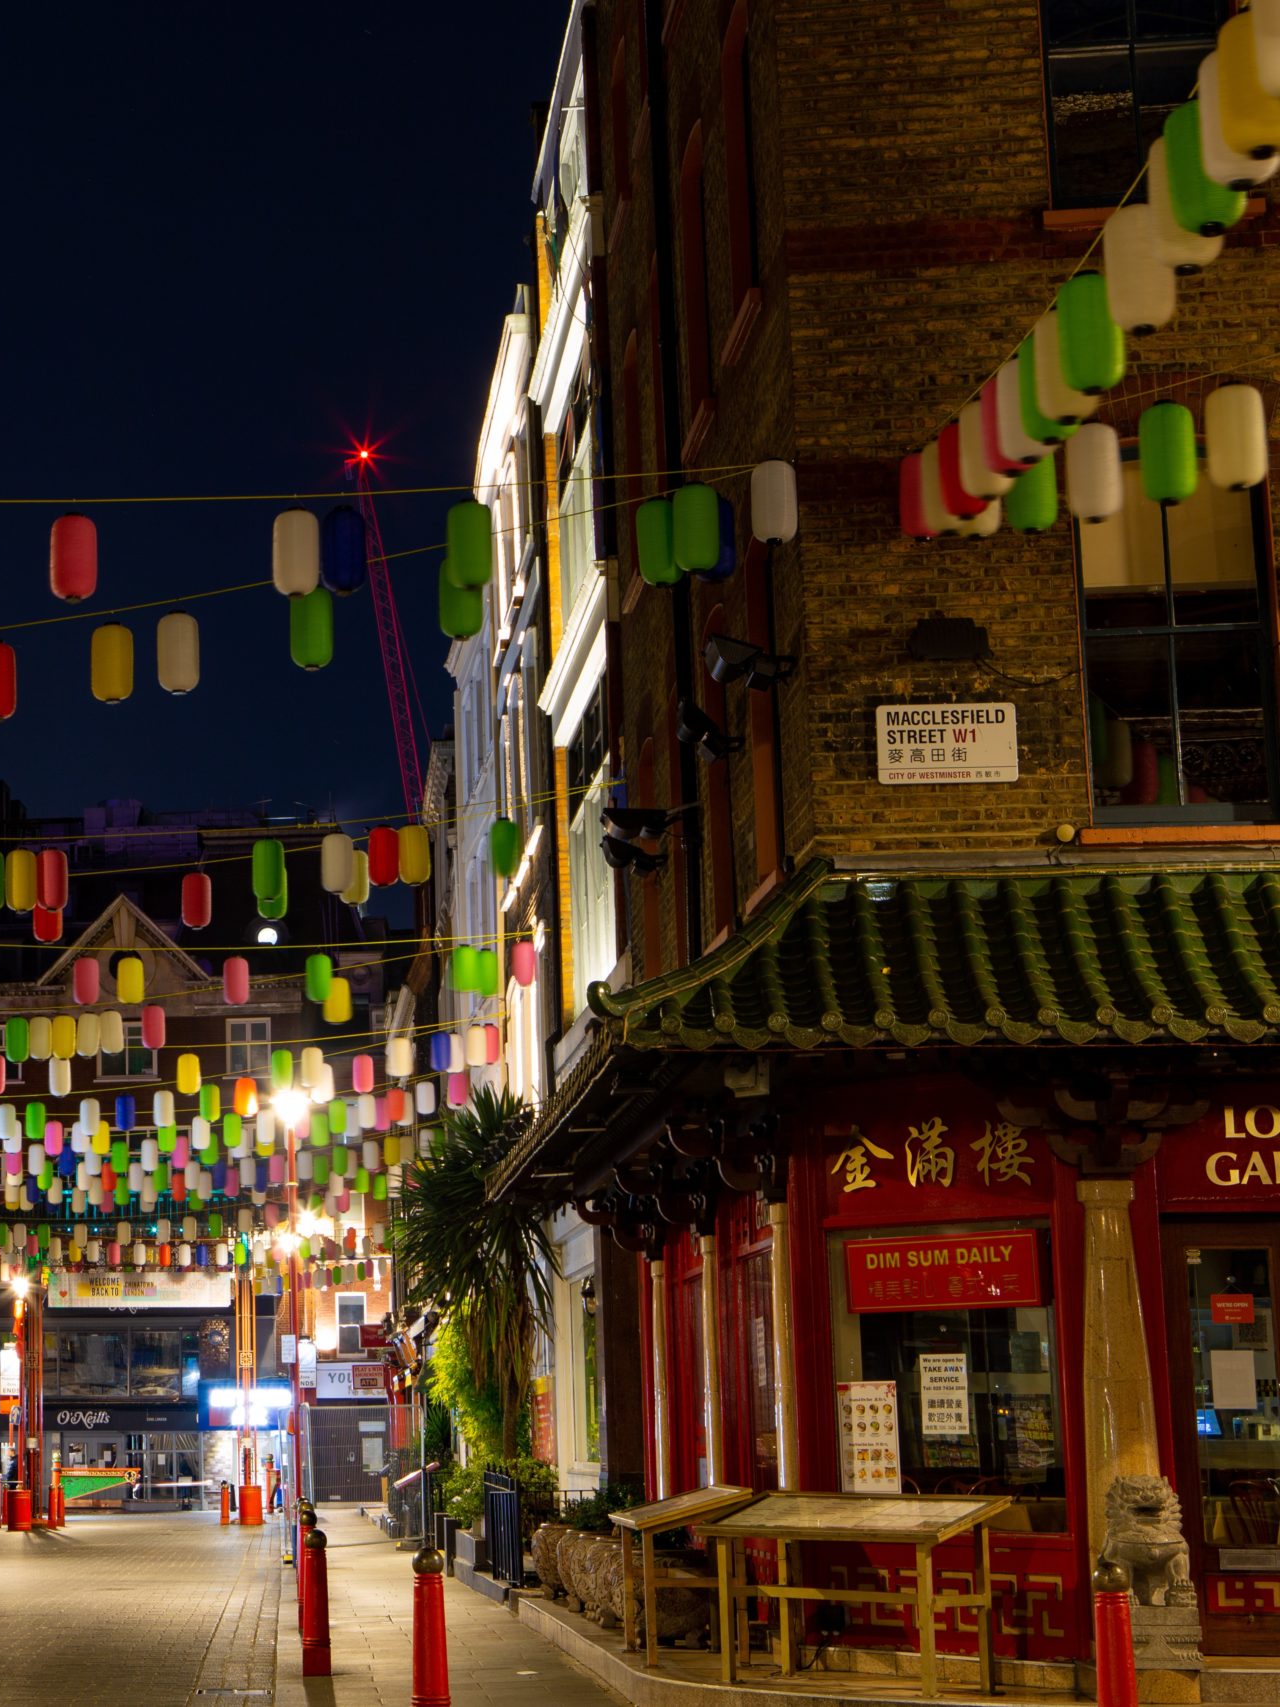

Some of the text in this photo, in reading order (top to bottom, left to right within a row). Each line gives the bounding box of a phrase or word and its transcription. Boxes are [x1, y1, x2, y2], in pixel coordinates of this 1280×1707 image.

[886, 709, 1005, 726] MACCLESFIELD
[887, 728, 977, 745] STREET W1
[888, 747, 968, 764] 麥高田街
[888, 770, 971, 780] CITY OF WESTMINSTER
[831, 1116, 1035, 1193] 金滿樓
[866, 1245, 1013, 1269] DIM SUM DAILY
[89, 1277, 120, 1286] WELCOME
[91, 1287, 119, 1296] BACK TO
[56, 1410, 111, 1429] O'Neill's
